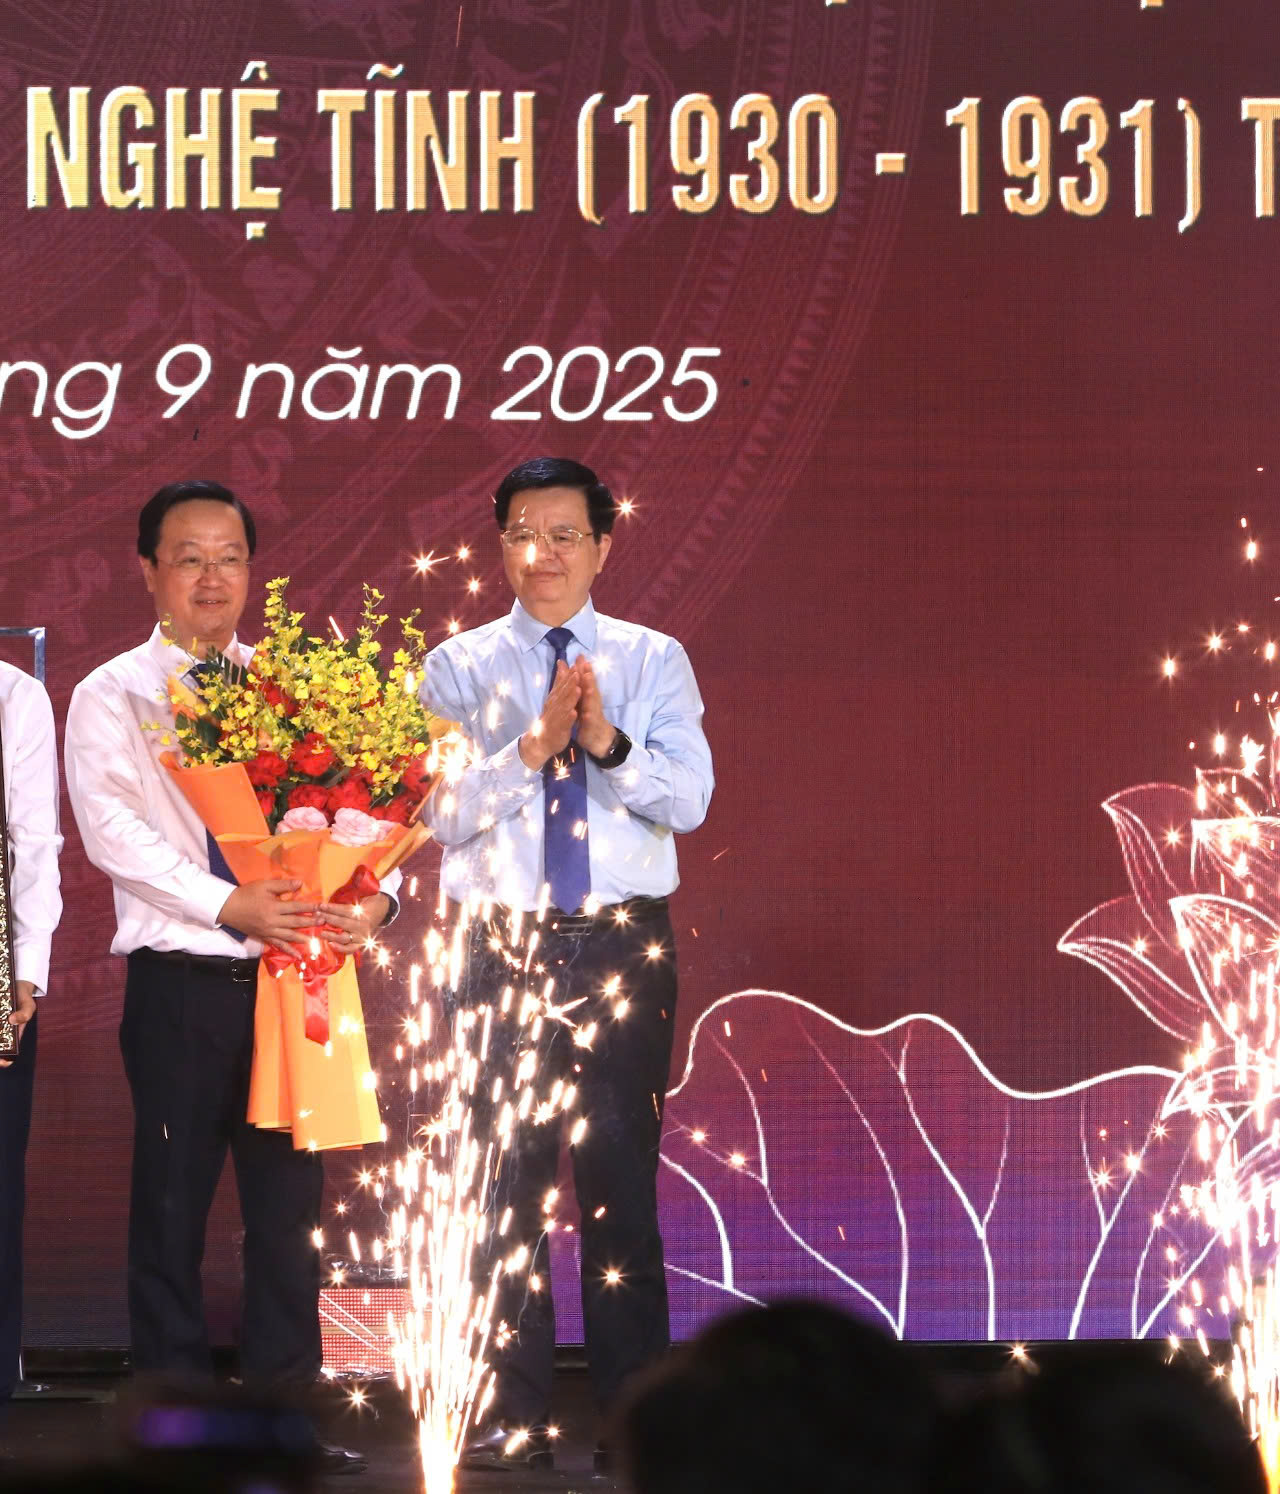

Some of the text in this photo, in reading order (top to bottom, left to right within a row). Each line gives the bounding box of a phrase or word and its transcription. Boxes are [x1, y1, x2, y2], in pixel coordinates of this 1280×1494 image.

[27, 61, 282, 240] NGHỆ
[318, 64, 536, 214] TĨNH
[577, 92, 838, 225] (1930
[875, 152, 907, 176] -
[945, 95, 1201, 232] 1931)
[155, 344, 212, 419] 9
[236, 346, 462, 421] năm
[491, 346, 721, 422] 2025
